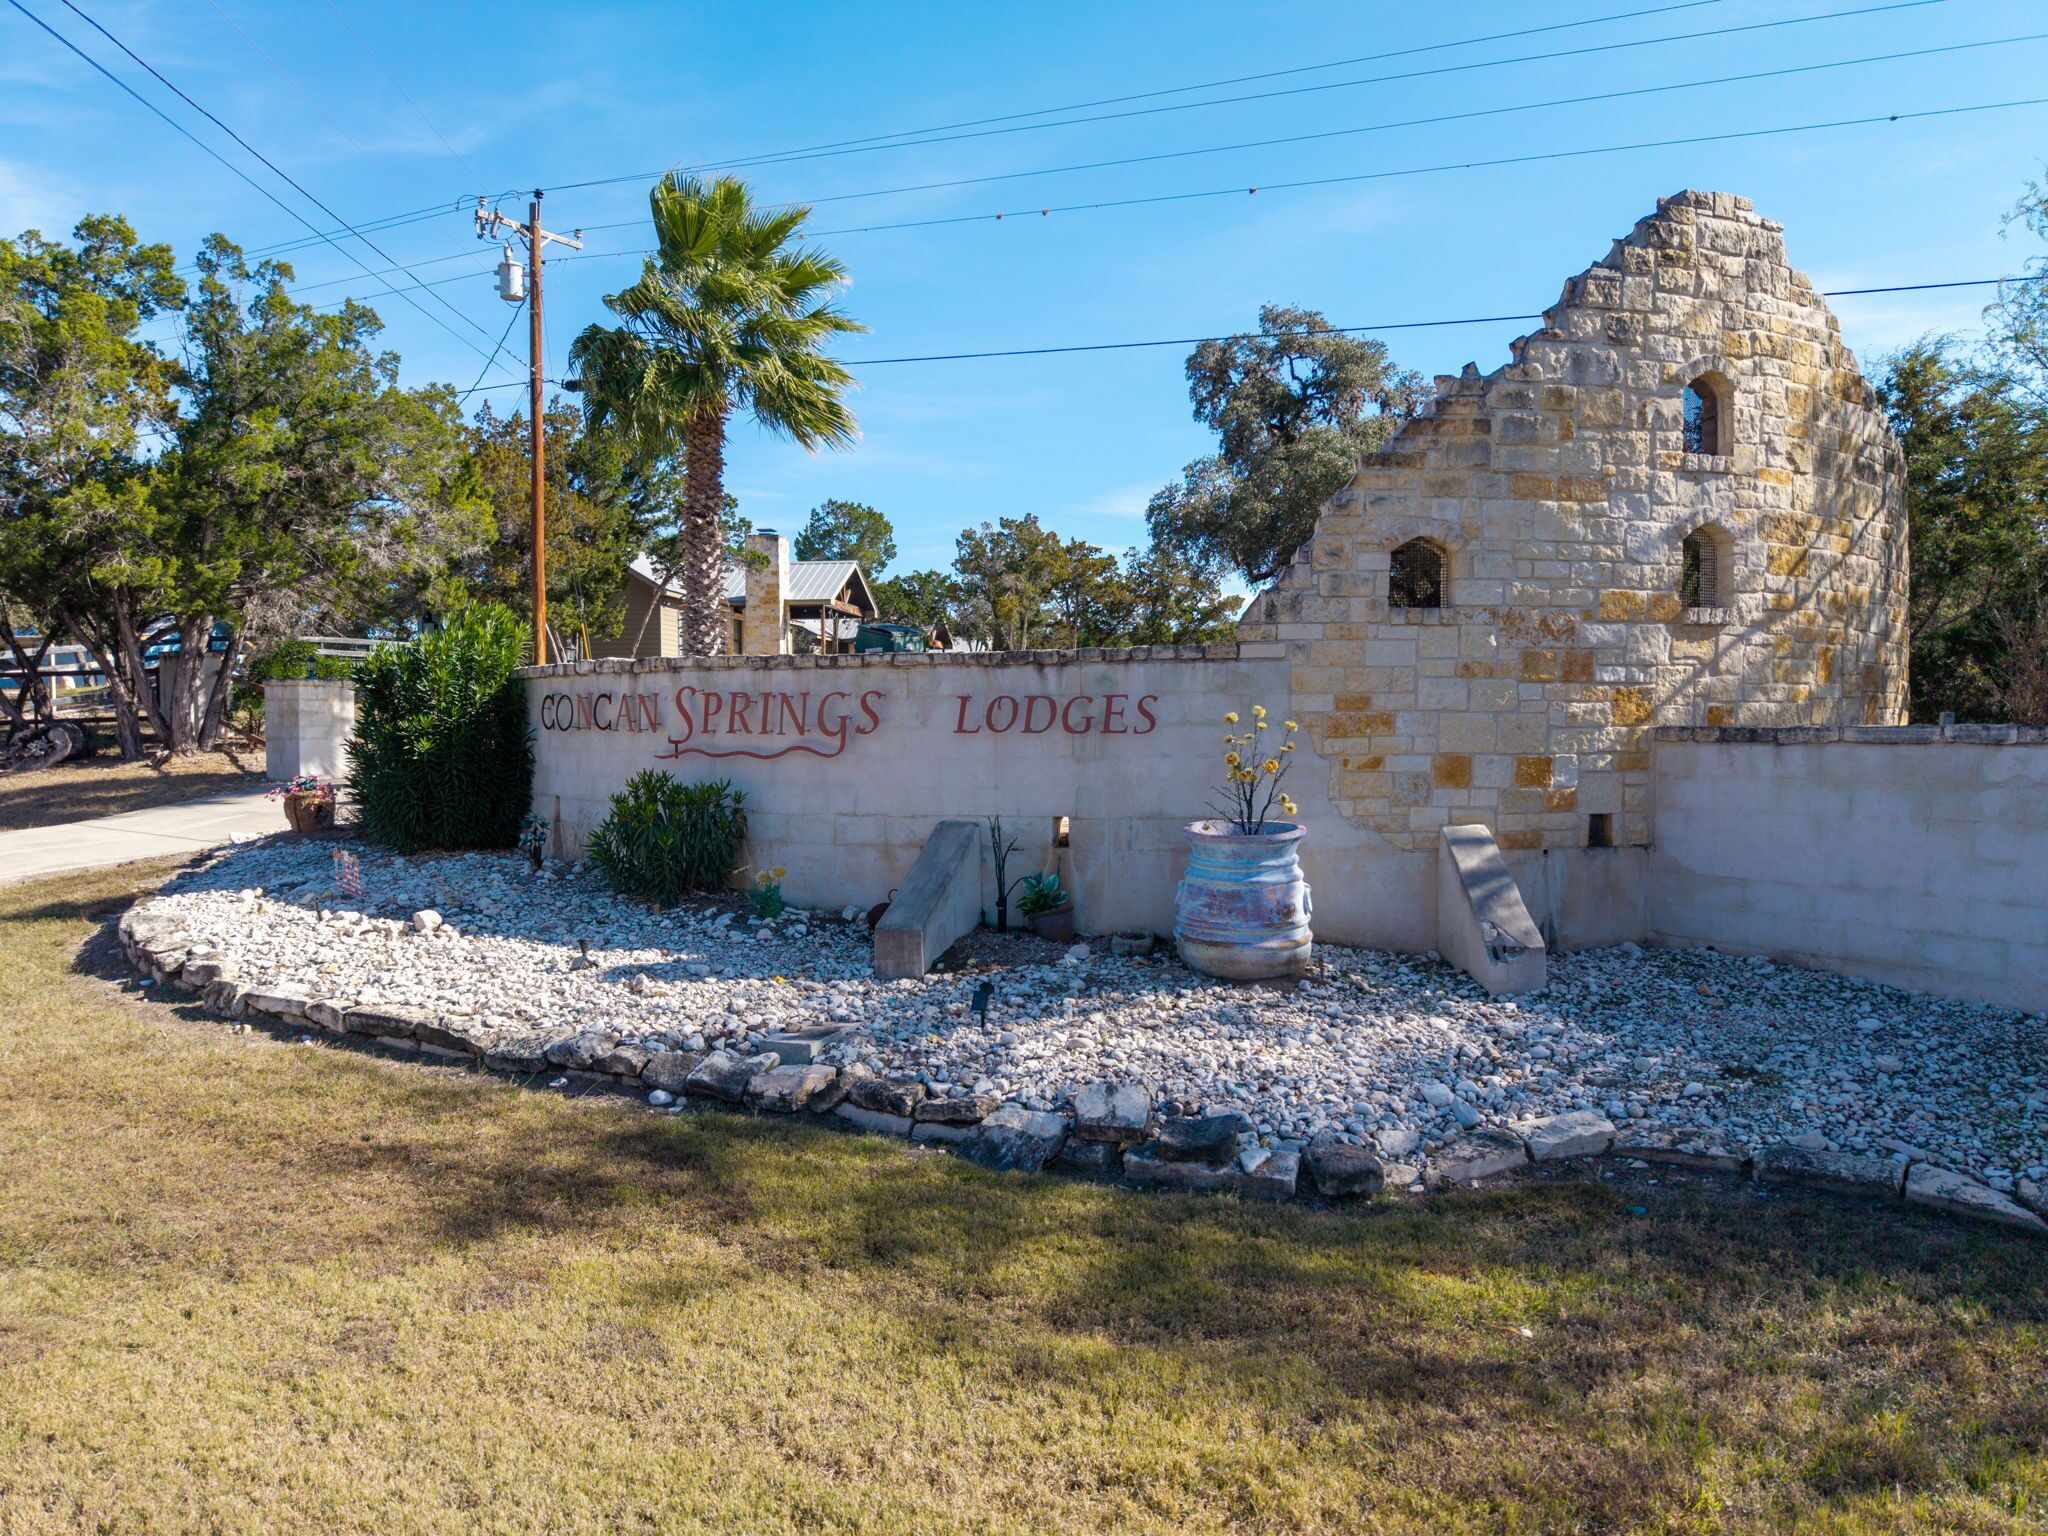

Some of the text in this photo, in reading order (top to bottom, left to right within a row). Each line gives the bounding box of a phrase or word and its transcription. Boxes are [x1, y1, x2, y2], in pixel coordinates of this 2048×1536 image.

[541, 686, 1159, 756] CONCAN SPRINGS LODGES
